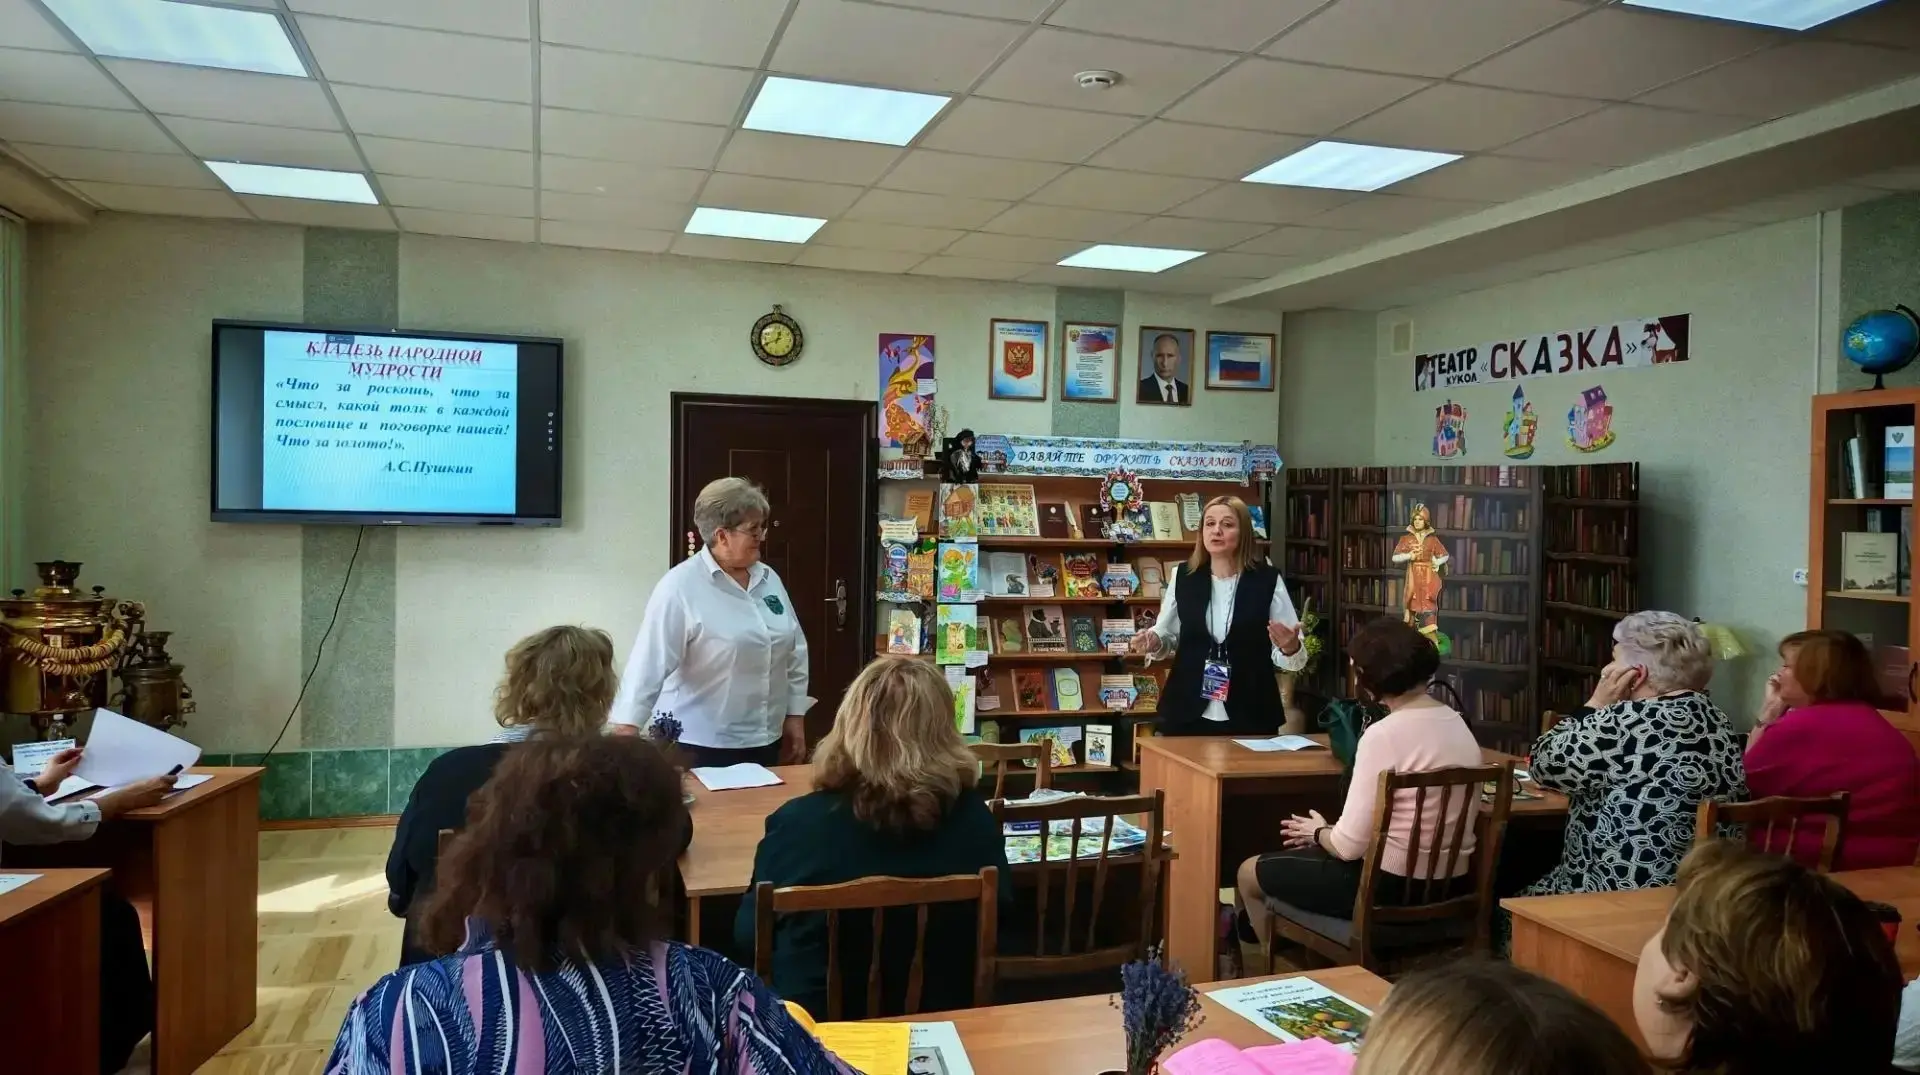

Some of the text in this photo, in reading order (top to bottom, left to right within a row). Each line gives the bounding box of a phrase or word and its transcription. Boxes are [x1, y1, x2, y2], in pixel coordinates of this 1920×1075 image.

[306, 341, 482, 362] КЛАДЕЗЬ НАРОДНОЙ
[1480, 325, 1637, 380] «СКАЗКА»
[349, 362, 442, 378] МУДРОСТИ
[1427, 347, 1477, 388] ТЕАТР
[1446, 372, 1477, 385] КУКОЛ
[275, 377, 510, 399] «Что за роскошь, что за
[275, 399, 510, 418] смысл, какой толк в каждой
[275, 418, 510, 435] пословице и поговорке нашей!
[277, 434, 310, 447] Что
[315, 439, 329, 447] за
[382, 460, 474, 475] А.С.Пушкин
[1094, 454, 1161, 465] ДРУЖИТЬ
